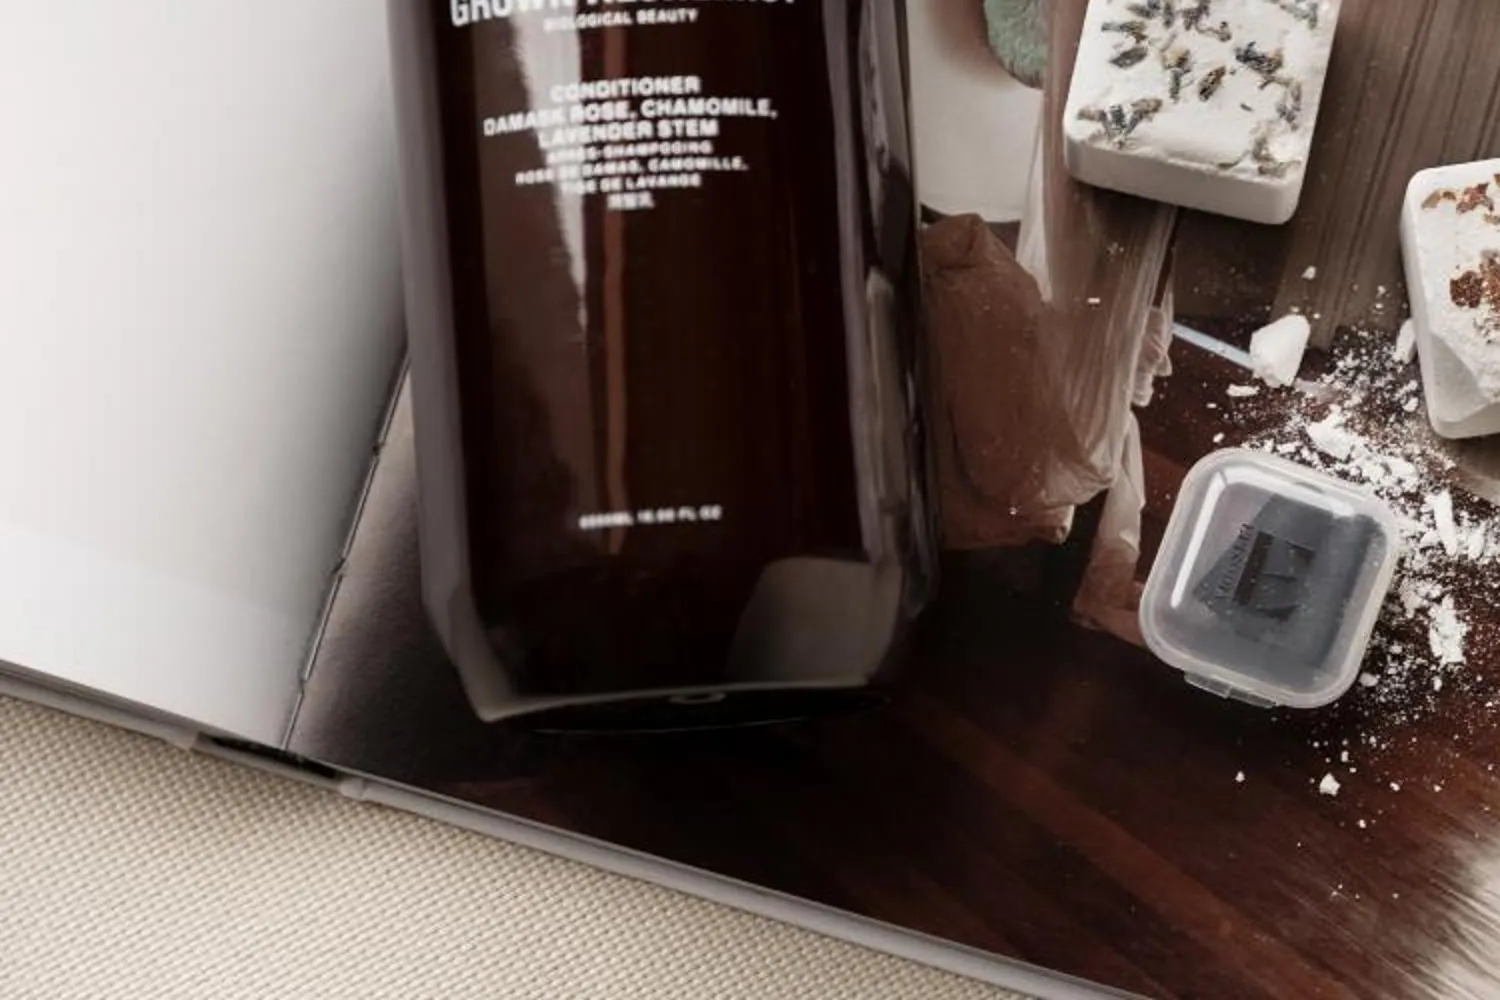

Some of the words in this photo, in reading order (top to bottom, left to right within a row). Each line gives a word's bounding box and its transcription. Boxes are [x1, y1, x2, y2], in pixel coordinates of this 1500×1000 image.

[636, 7, 698, 25] BEAUTY
[549, 75, 701, 100] CONDITIONER
[640, 97, 778, 119] CHAMOMILE,
[538, 121, 653, 149] LAVENDER
[657, 118, 719, 137] STEM
